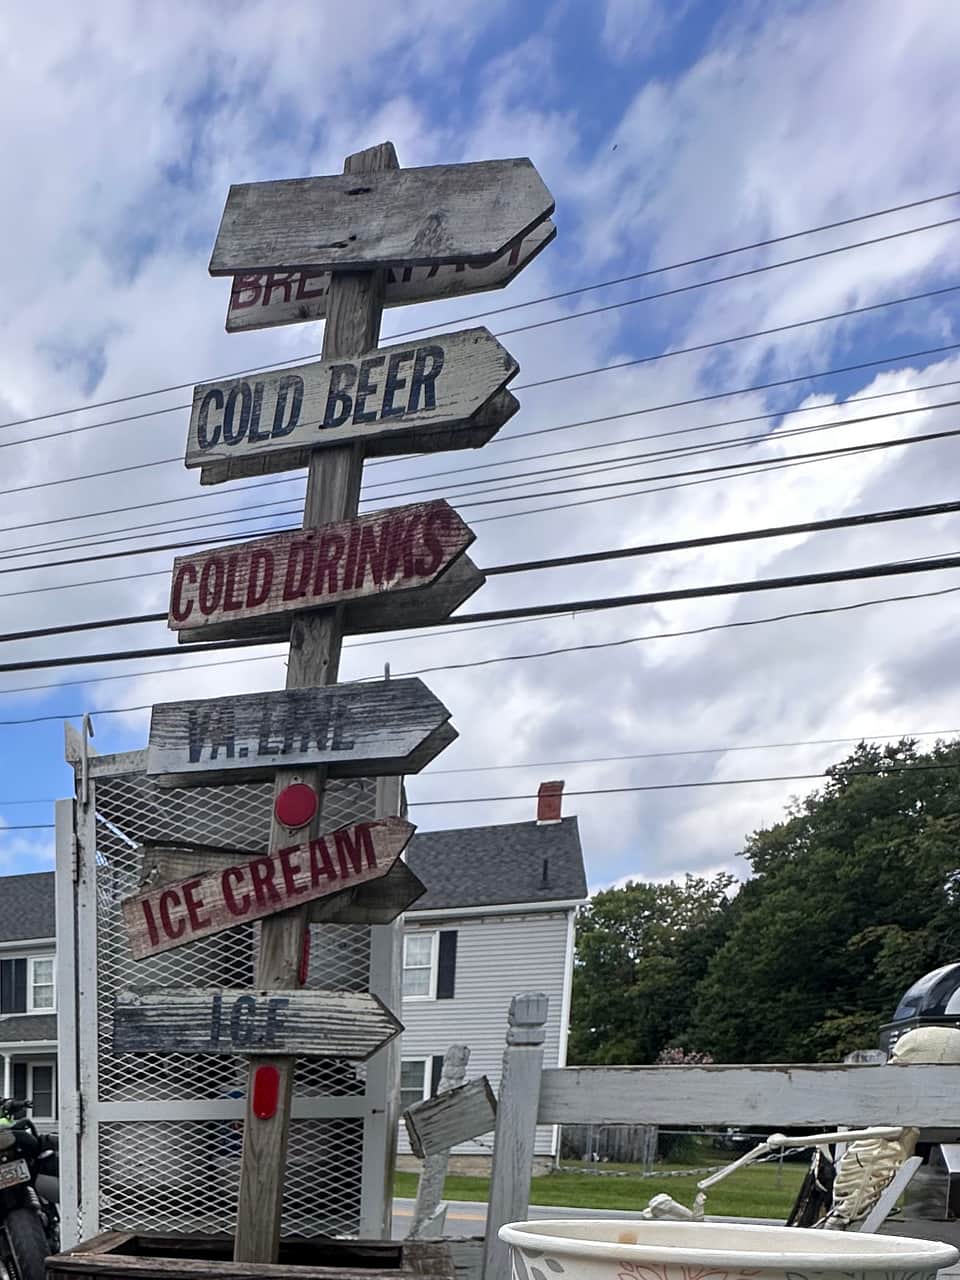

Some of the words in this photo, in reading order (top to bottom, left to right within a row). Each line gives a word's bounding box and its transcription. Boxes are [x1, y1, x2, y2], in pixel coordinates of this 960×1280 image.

[197, 374, 303, 450] COLD
[318, 344, 446, 430] BEER
[171, 548, 275, 622] COLD
[282, 508, 450, 602] DRINKS
[141, 879, 212, 947] ICE
[220, 822, 380, 918] CREAM
